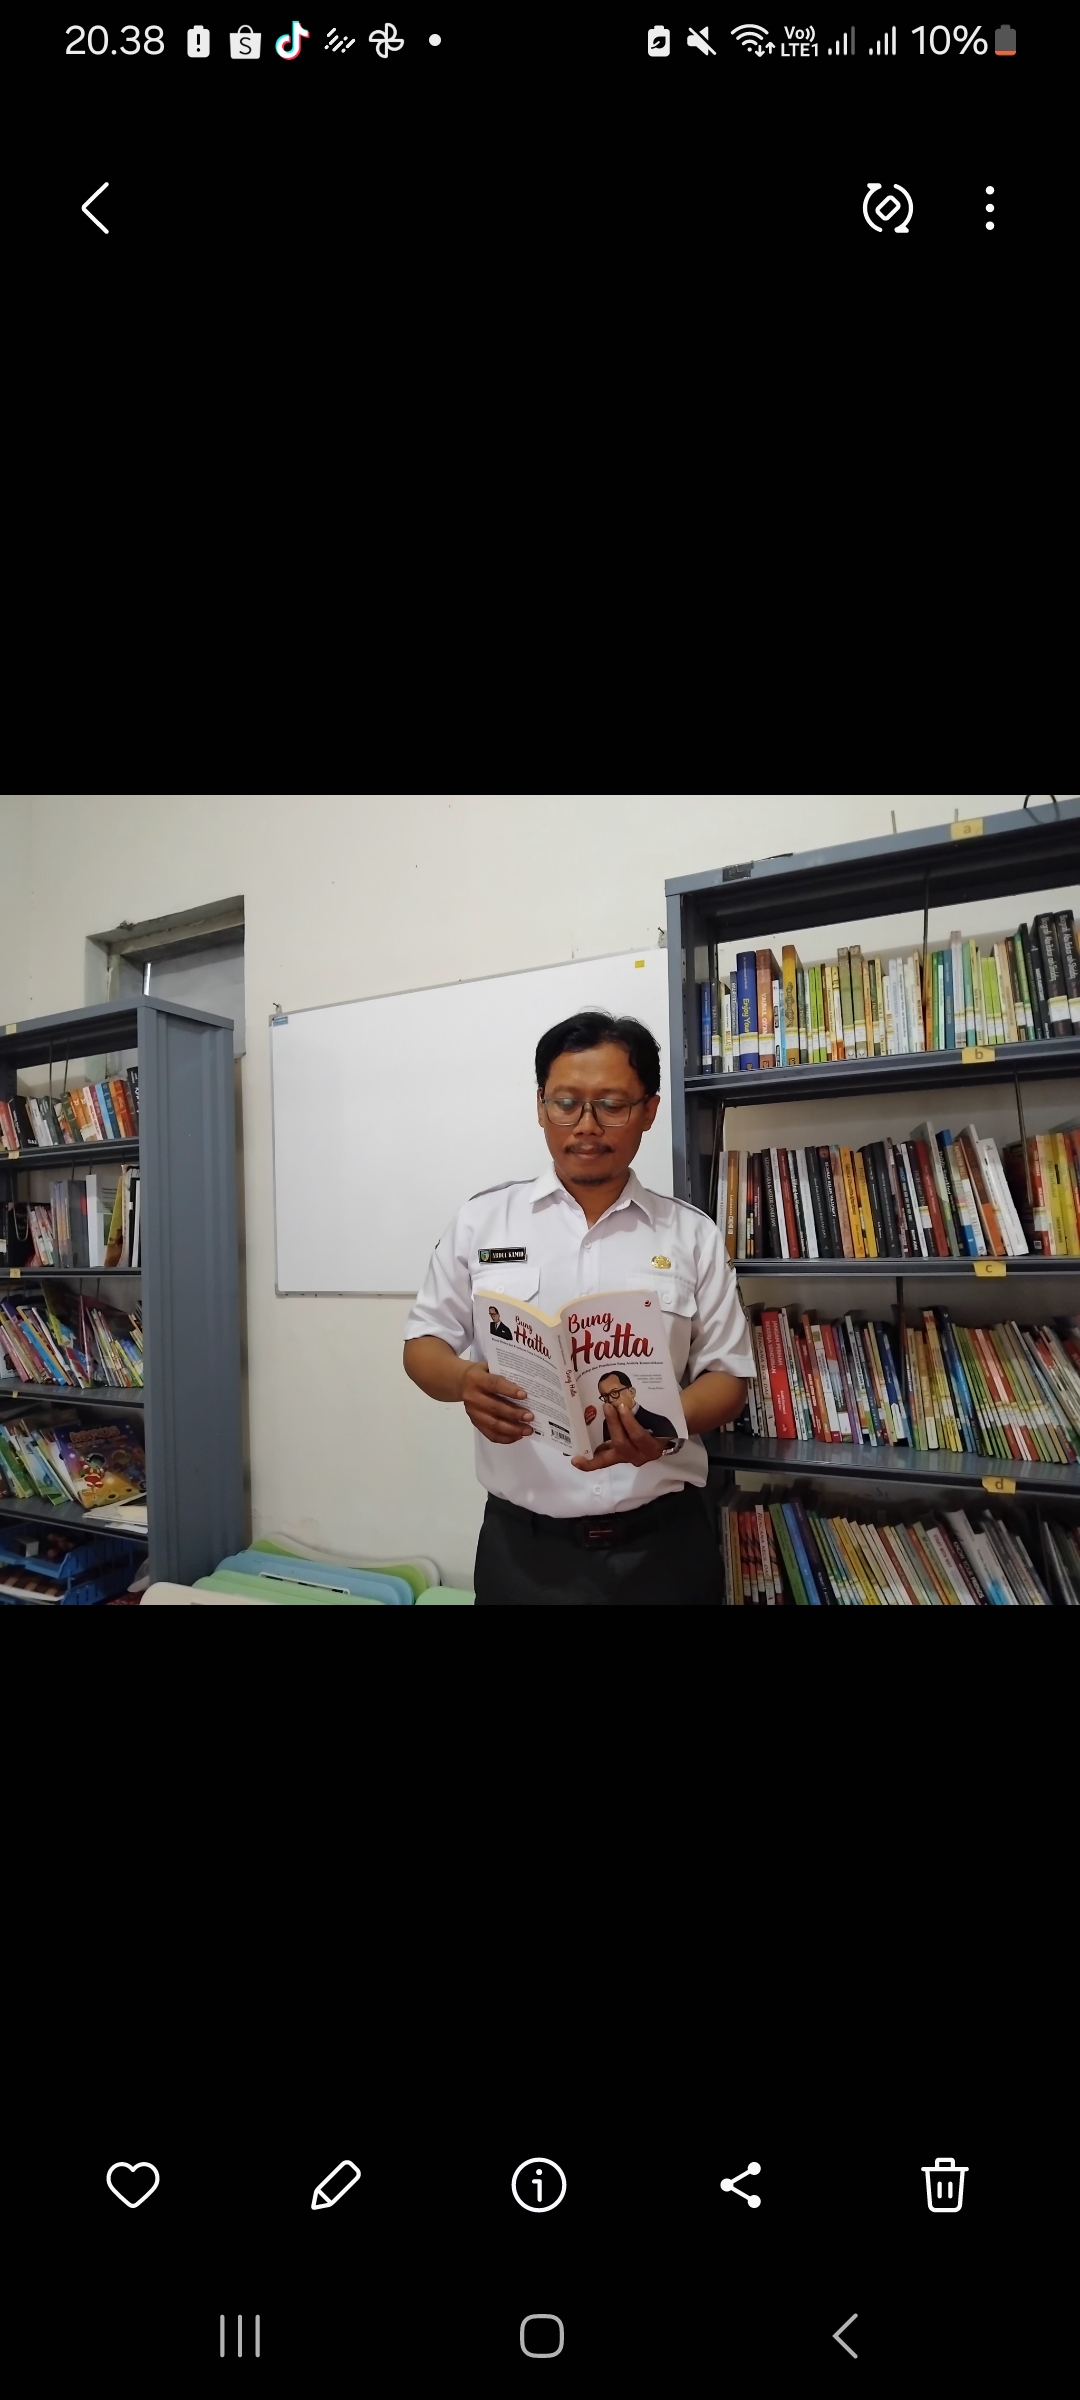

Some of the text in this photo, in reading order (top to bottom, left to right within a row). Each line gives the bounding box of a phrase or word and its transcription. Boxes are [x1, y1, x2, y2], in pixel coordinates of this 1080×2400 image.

[65, 25, 165, 55] 20.38
[781, 43, 818, 57] LTE1
[911, 25, 988, 56] 10%
[962, 825, 971, 834] a
[742, 999, 750, 1016] Enjoy
[974, 1048, 984, 1060] b
[516, 1316, 533, 1334] Bung
[568, 1312, 614, 1334] Bung
[514, 1326, 552, 1360] Hatta
[571, 1323, 654, 1372] Hatta
[756, 1331, 766, 1363] RENCANA
[764, 1321, 777, 1374] BEKERJA SENDIRIAN
[772, 1320, 783, 1366] JANGAN PERNAH
[995, 1478, 1004, 1490] d
[757, 1512, 765, 1544] RENCANA
[933, 1534, 942, 1547] START
[953, 1541, 985, 1599] KNOW YOUR FRIENDS
